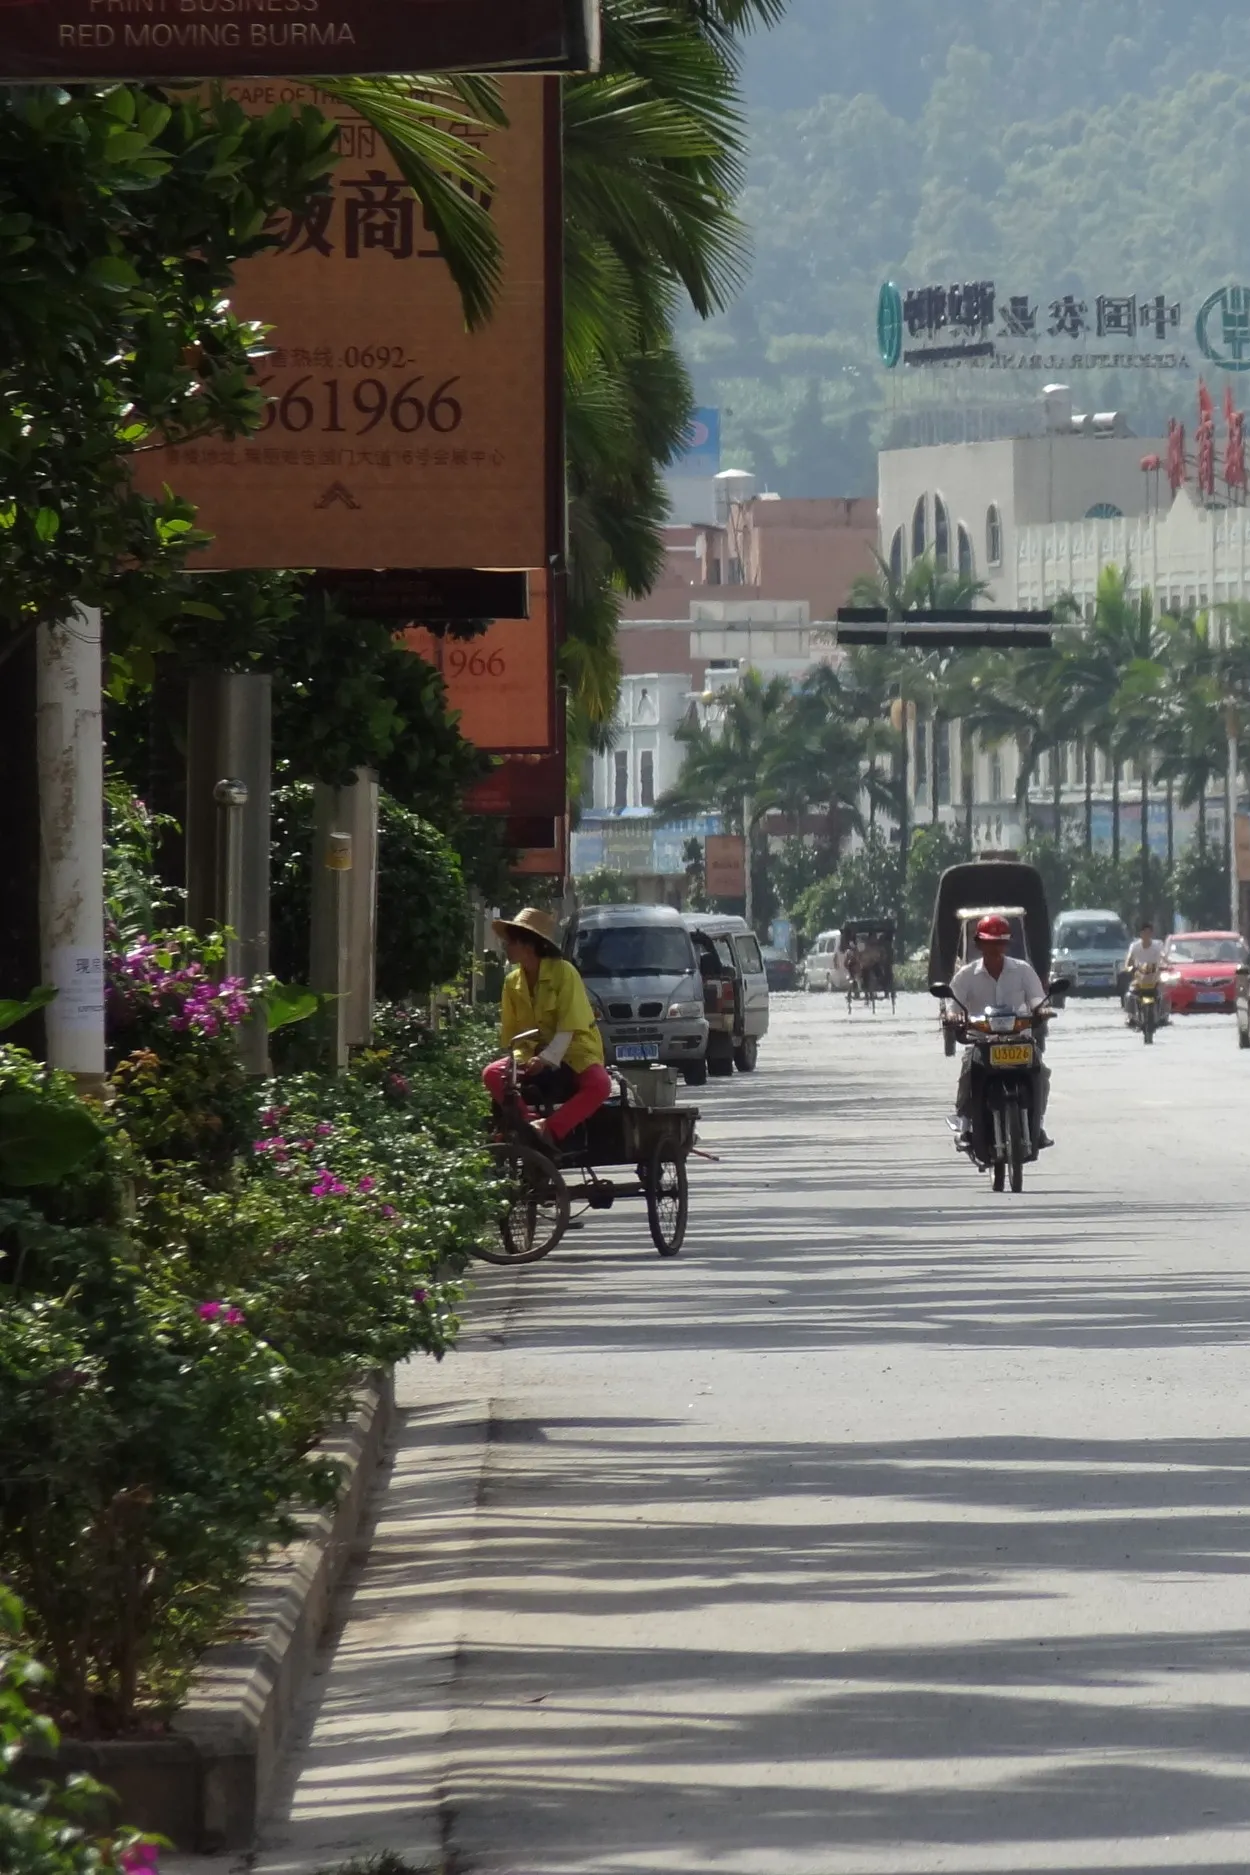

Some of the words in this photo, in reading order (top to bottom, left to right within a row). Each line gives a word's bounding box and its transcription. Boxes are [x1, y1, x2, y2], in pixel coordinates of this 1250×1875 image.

[59, 23, 115, 47] RED
[124, 22, 241, 47] MOVING
[250, 22, 357, 46] BURMA
